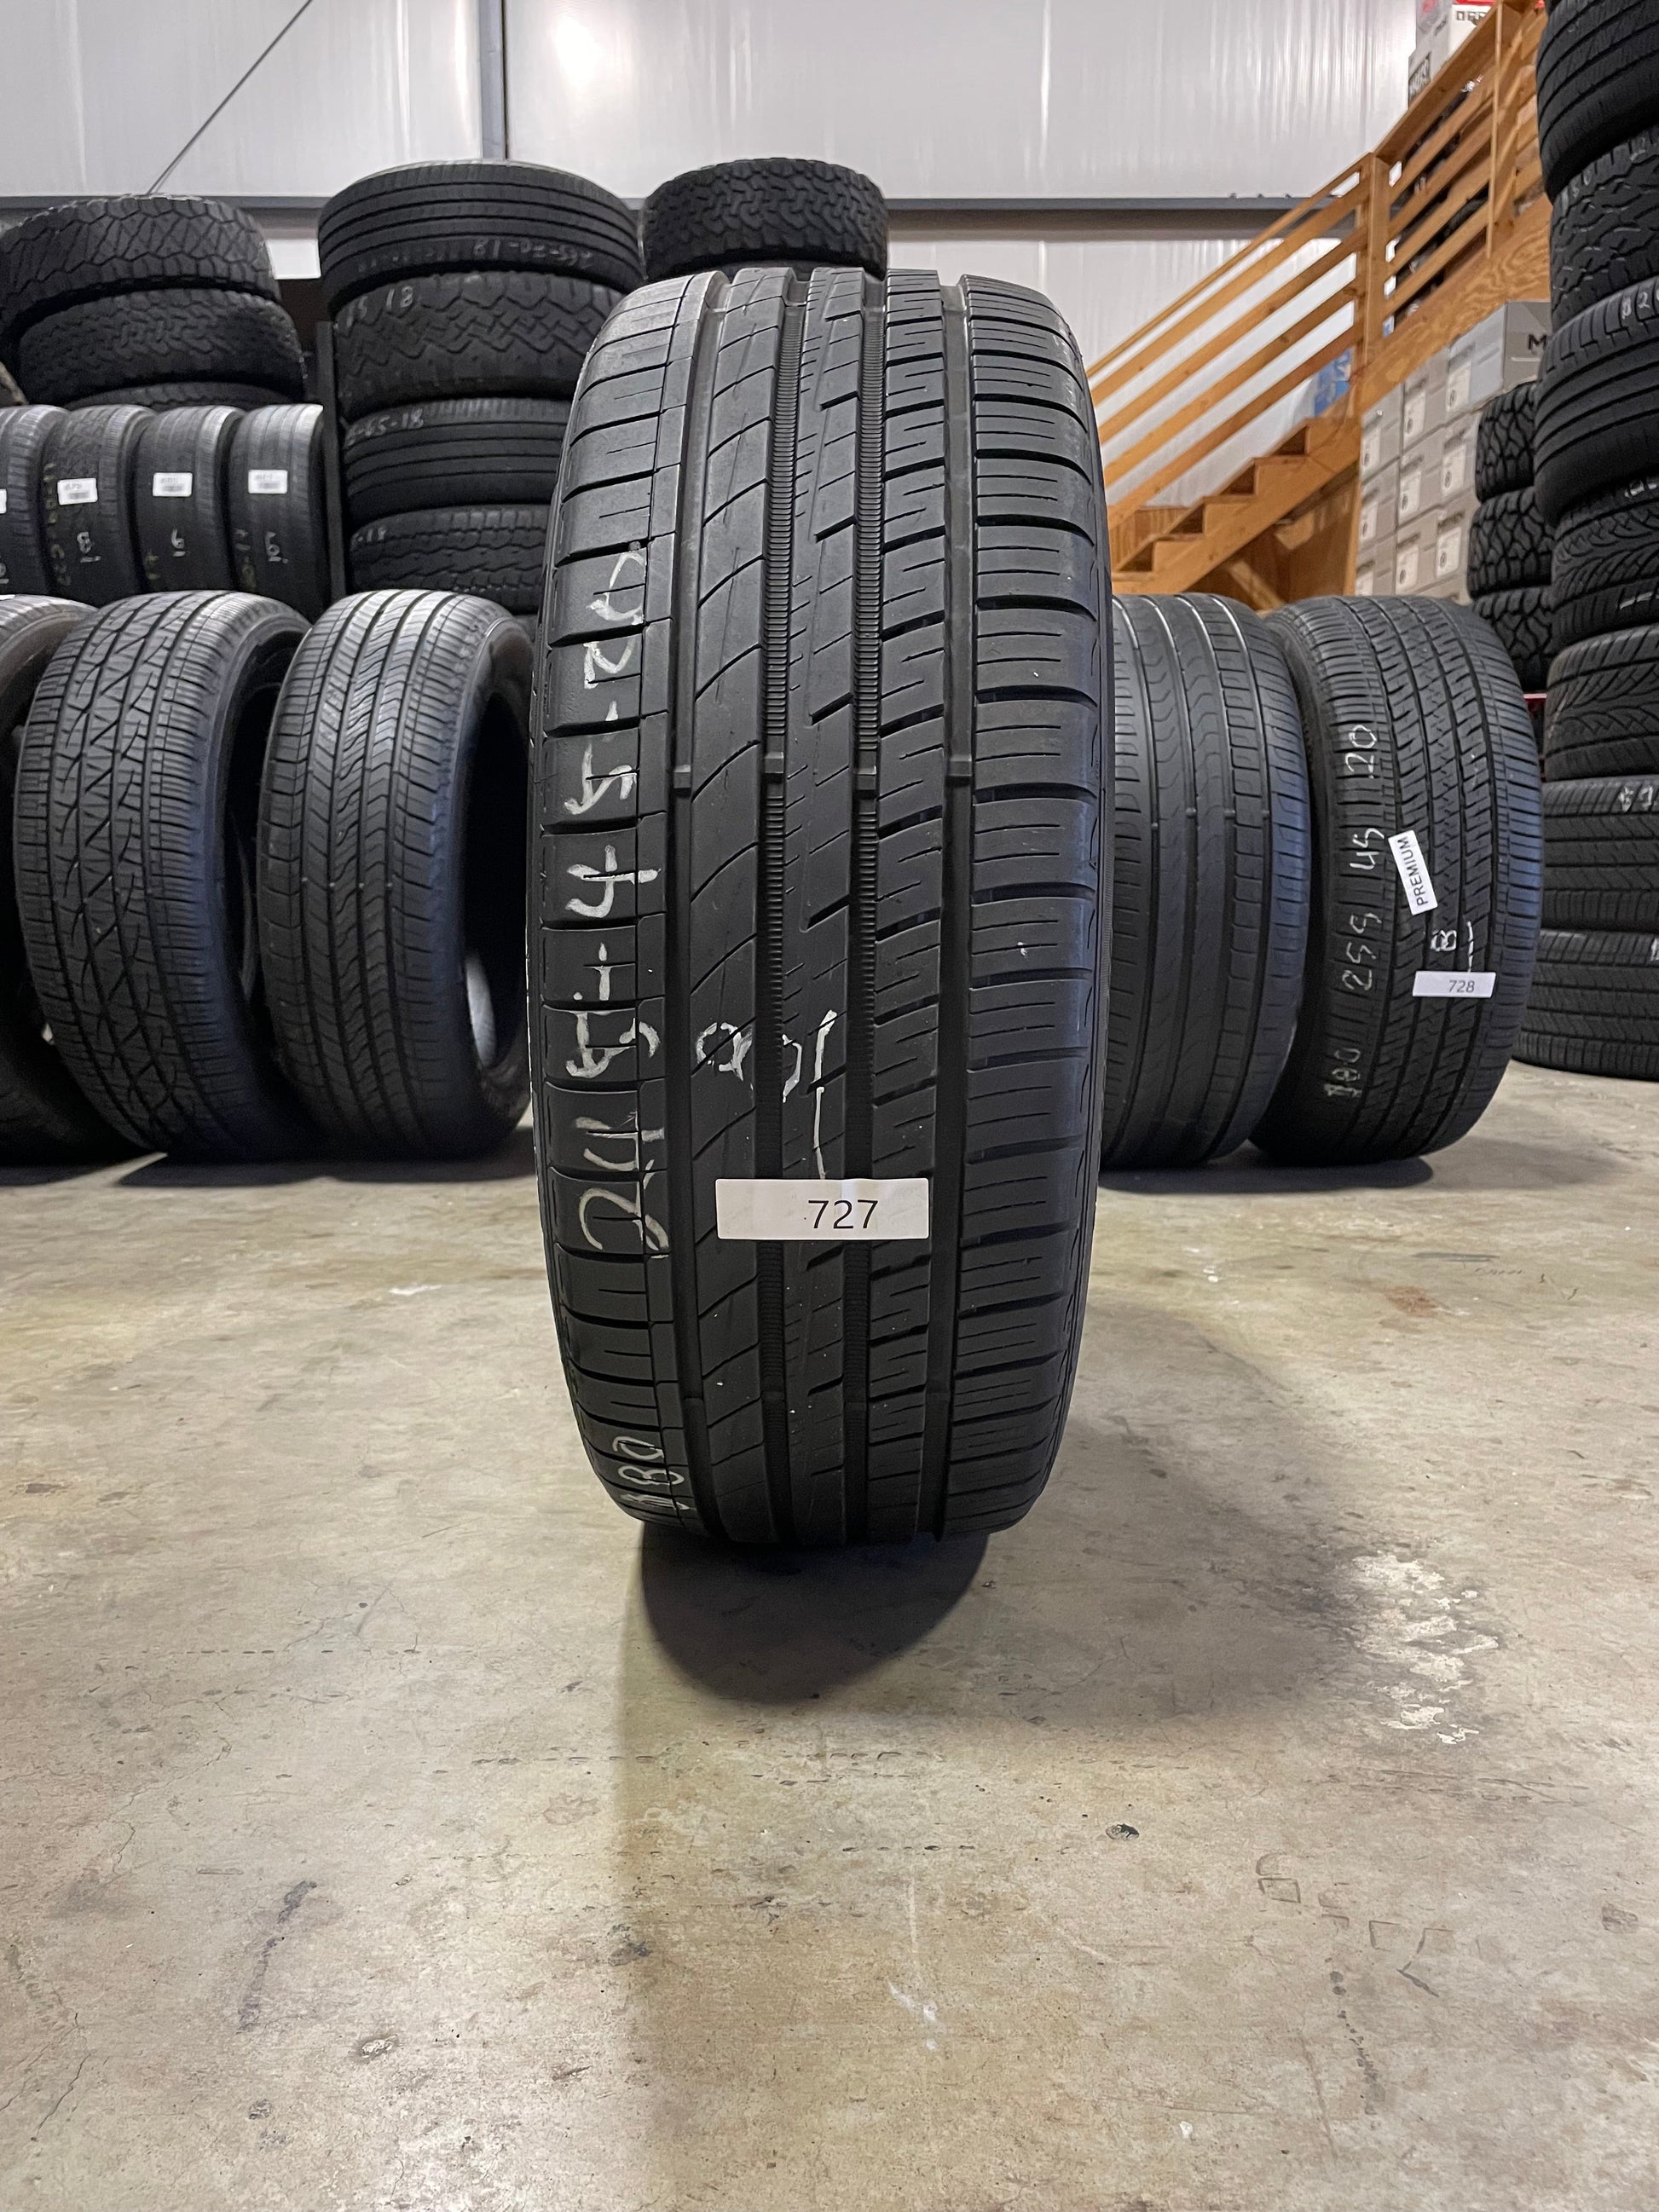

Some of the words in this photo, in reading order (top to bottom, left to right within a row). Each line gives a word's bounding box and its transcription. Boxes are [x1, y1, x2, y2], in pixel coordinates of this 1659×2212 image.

[1350, 827, 1384, 870] 45
[1396, 836, 1429, 907] PREMIUM
[1342, 912, 1382, 990] 255
[1448, 979, 1476, 994] 728
[807, 1199, 879, 1229] 727
